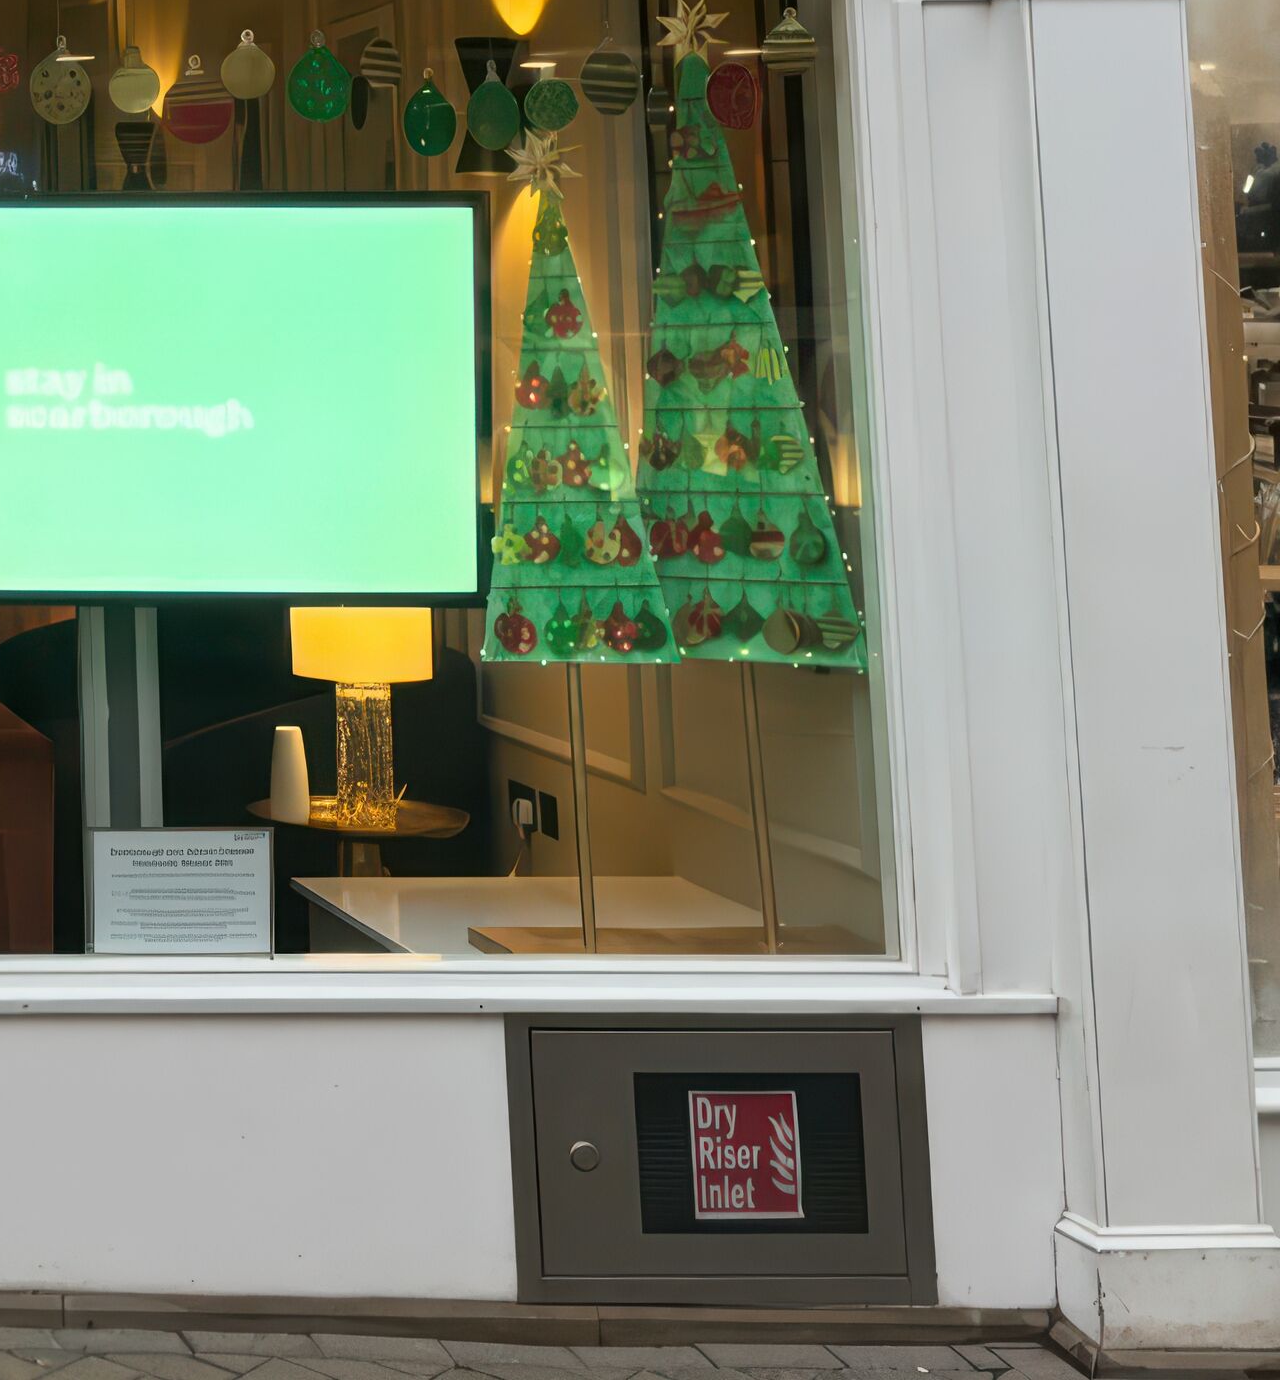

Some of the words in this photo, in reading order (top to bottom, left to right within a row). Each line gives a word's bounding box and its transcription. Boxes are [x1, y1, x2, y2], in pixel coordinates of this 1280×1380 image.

[5, 369, 87, 400] stay
[93, 362, 133, 395] in
[697, 1097, 737, 1139] Dry
[699, 1136, 761, 1170] Riser
[701, 1175, 756, 1209] Inlet
